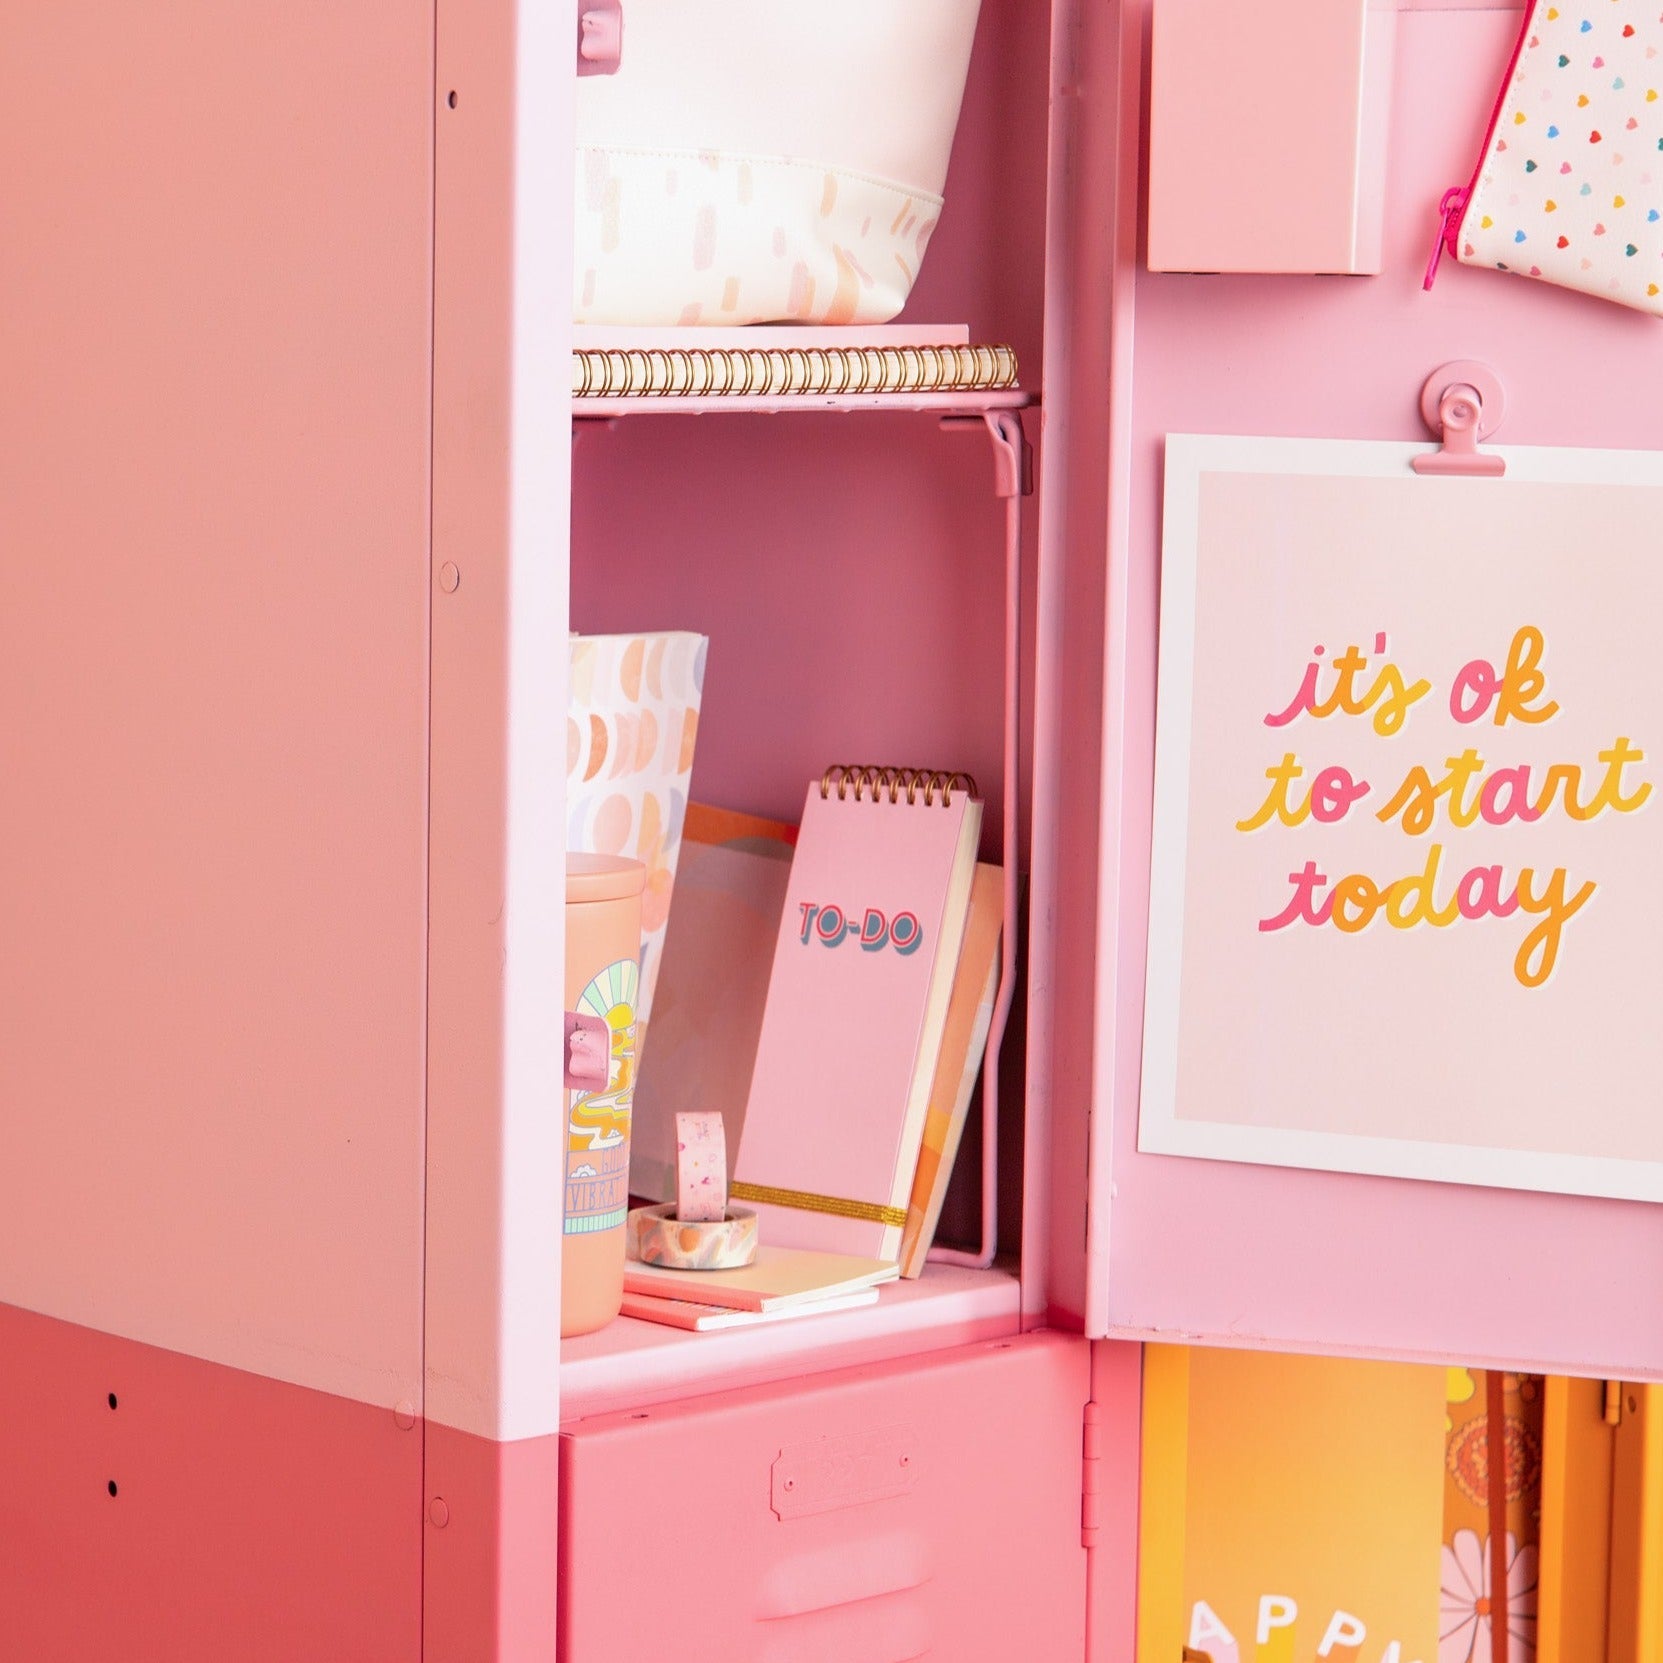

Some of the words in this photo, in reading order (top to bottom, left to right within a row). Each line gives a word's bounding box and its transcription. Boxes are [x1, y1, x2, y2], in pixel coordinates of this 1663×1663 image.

[1263, 631, 1433, 737] it's
[1449, 625, 1561, 727] ok
[1235, 752, 1371, 832] to
[1375, 737, 1654, 836] start
[799, 902, 923, 955] TO-DO
[1258, 843, 1598, 988] today
